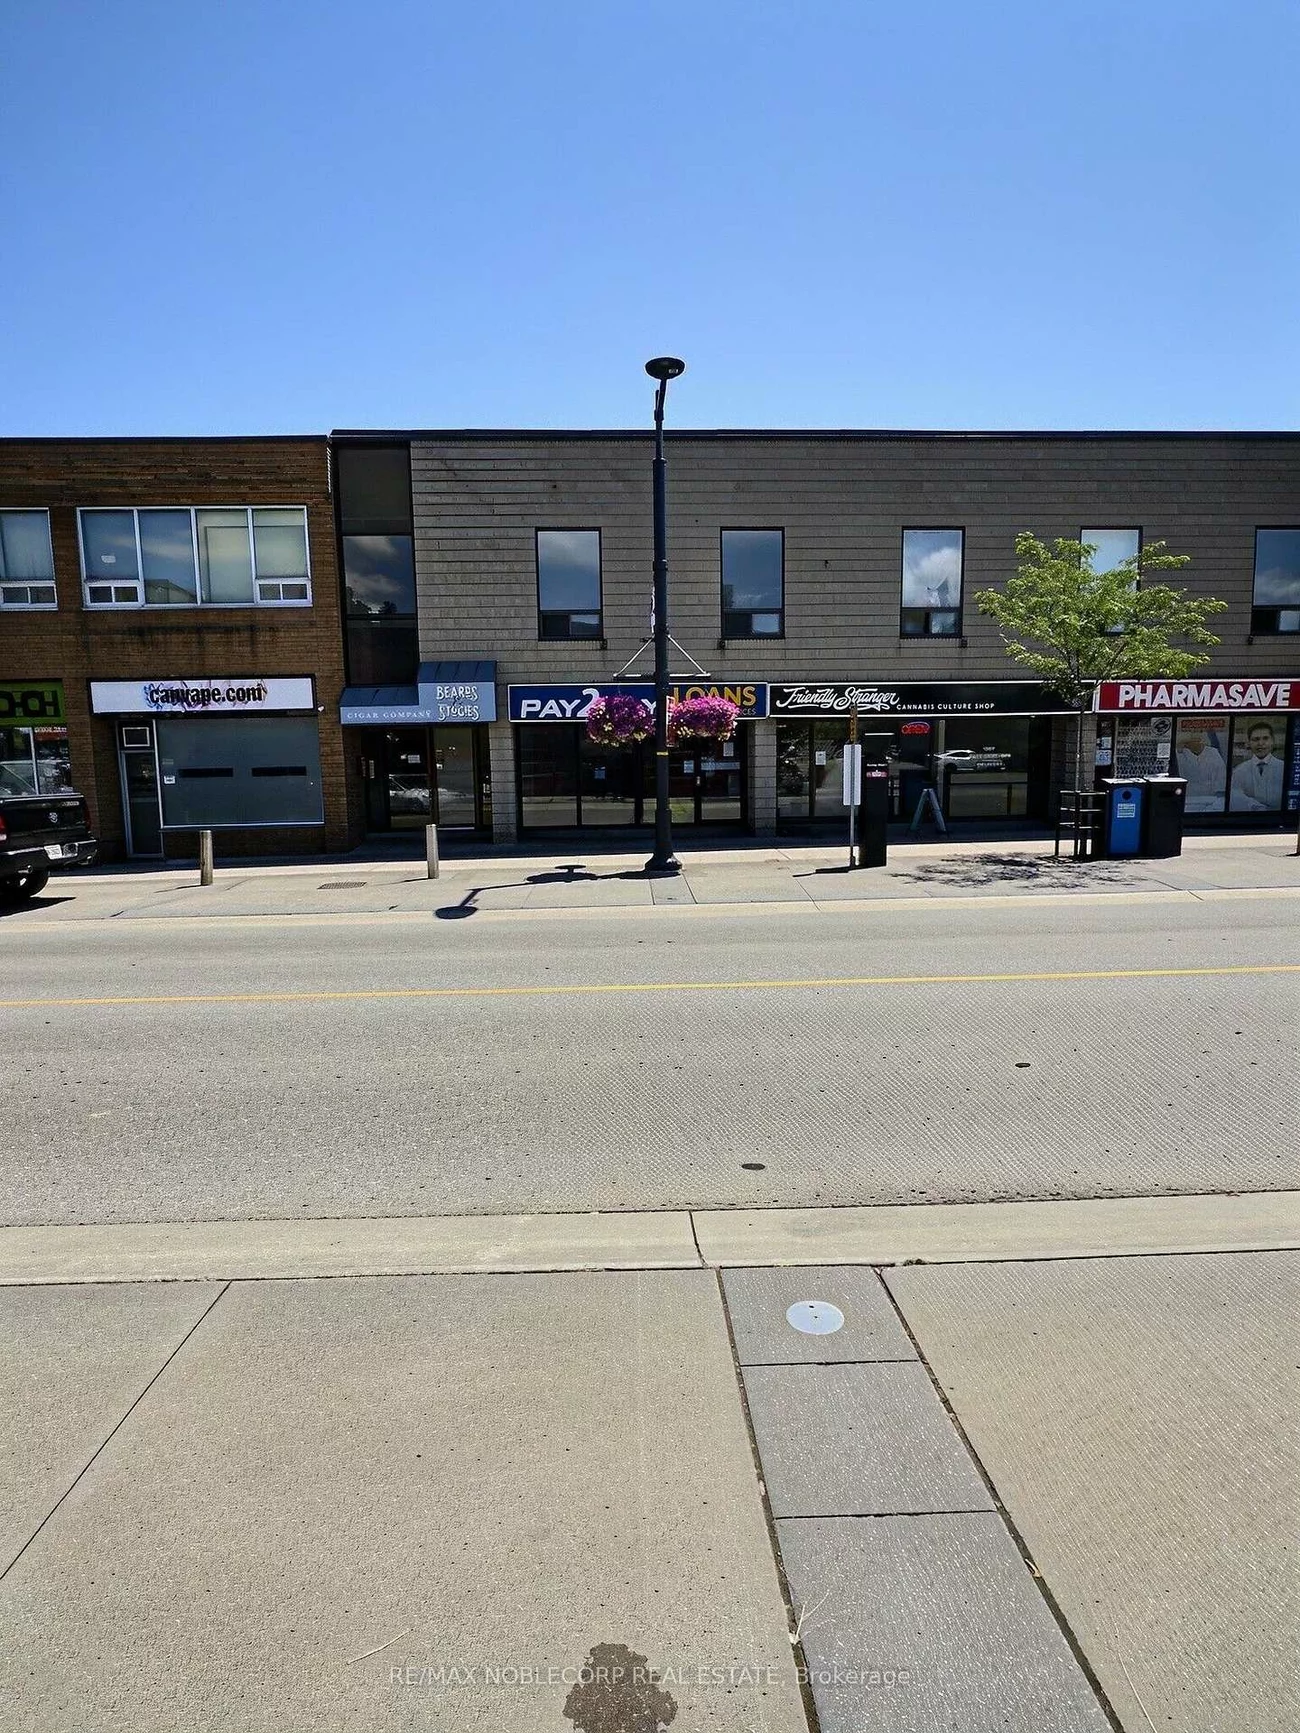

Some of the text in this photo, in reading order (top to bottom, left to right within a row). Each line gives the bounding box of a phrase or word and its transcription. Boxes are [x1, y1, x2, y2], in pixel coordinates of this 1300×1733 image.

[436, 685, 478, 700] BEARDS
[776, 686, 900, 711] Friendly Stranger
[1118, 683, 1291, 708] PHARMASAVE
[383, 709, 432, 719] COMPANY
[438, 703, 479, 721] STOGIES
[896, 703, 935, 711] CANNABIS
[938, 702, 972, 710] CULTURE
